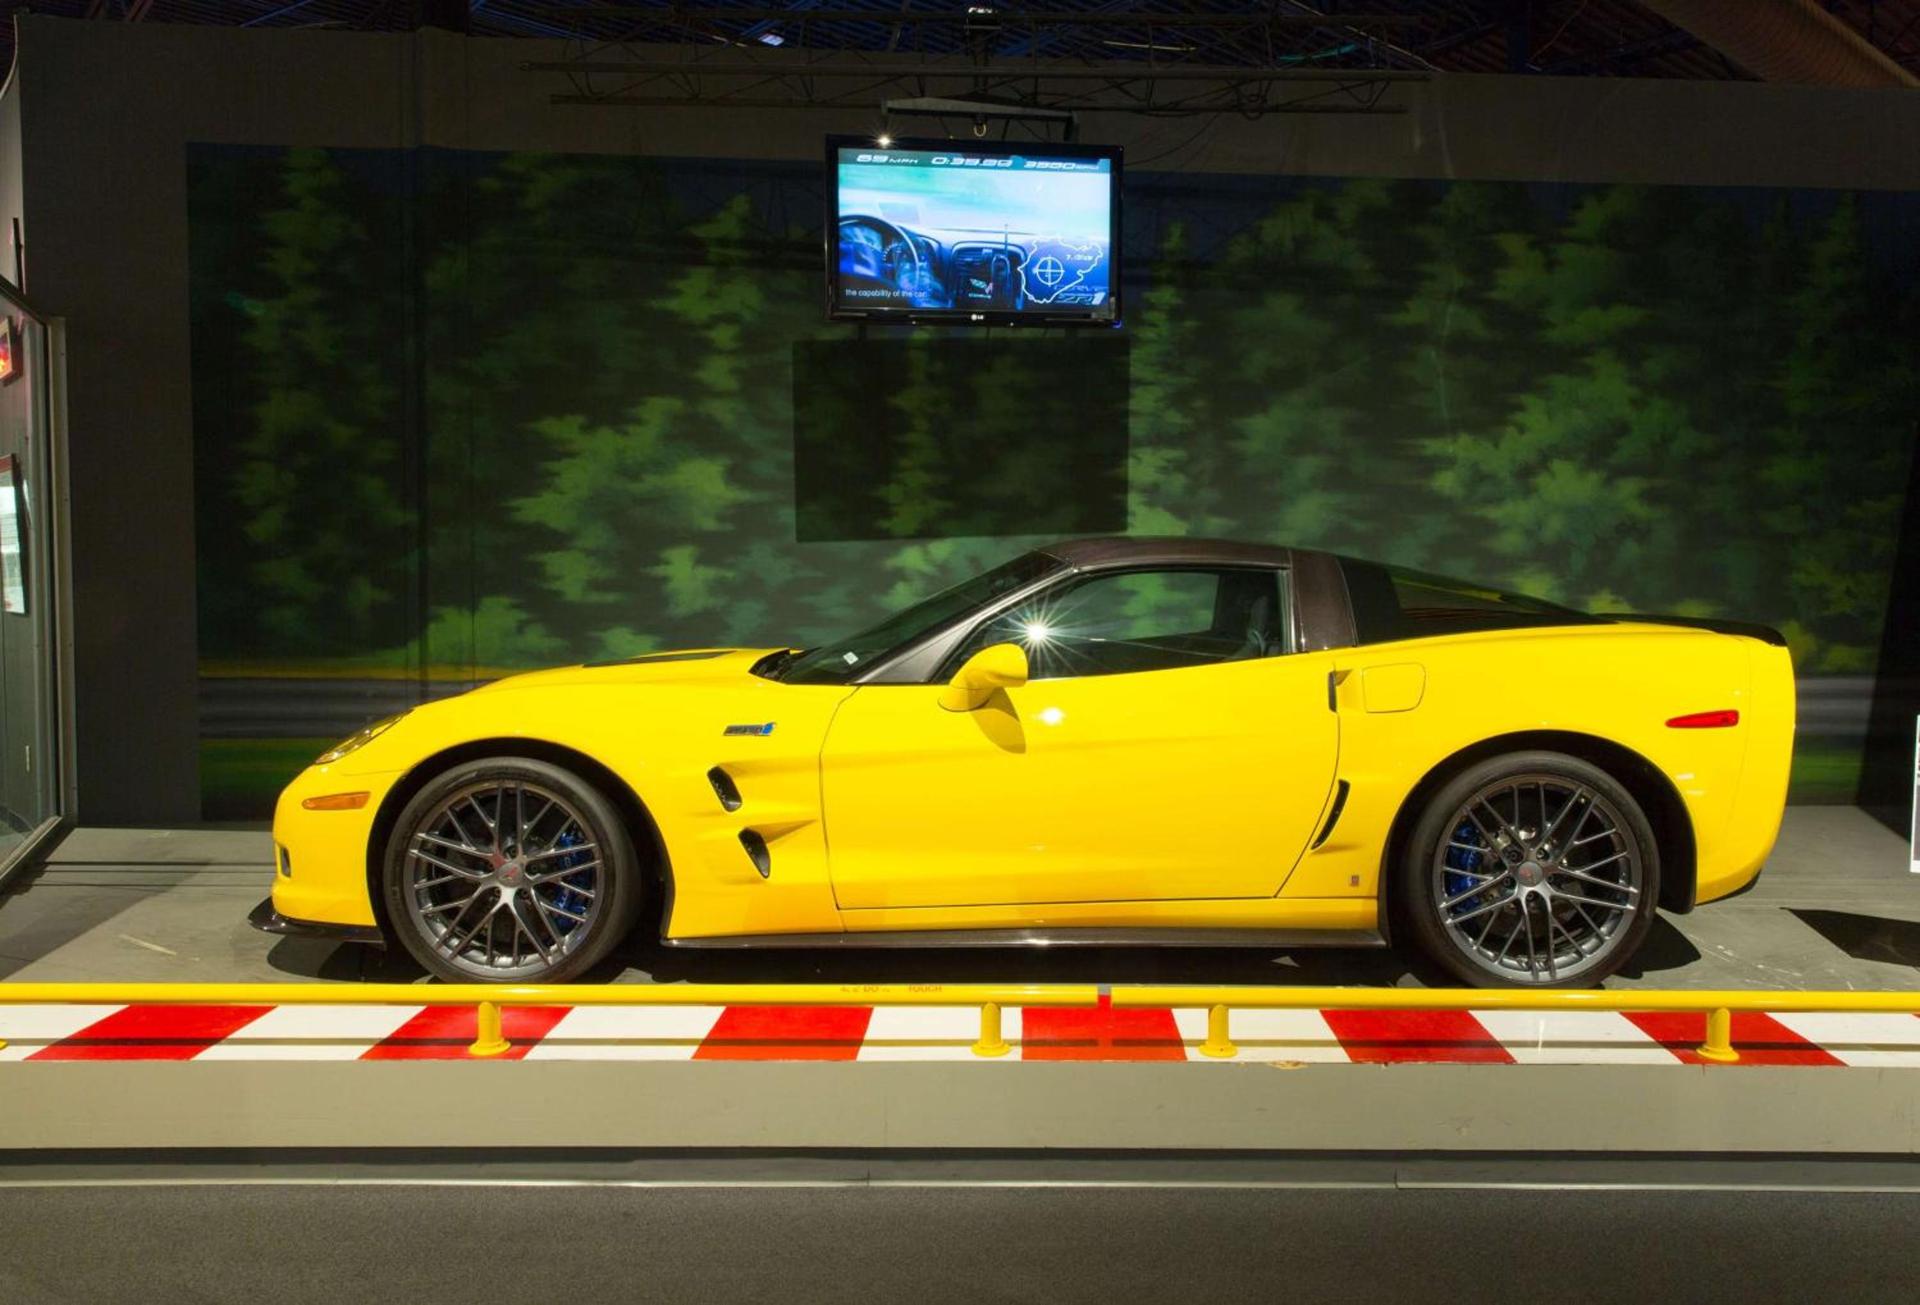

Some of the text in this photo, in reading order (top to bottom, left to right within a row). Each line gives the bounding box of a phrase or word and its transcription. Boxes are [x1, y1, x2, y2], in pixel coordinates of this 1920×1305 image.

[845, 288, 857, 296] the
[858, 289, 891, 298] capability
[893, 289, 900, 297] of
[901, 290, 913, 298] the
[908, 984, 942, 993] TOUCH
